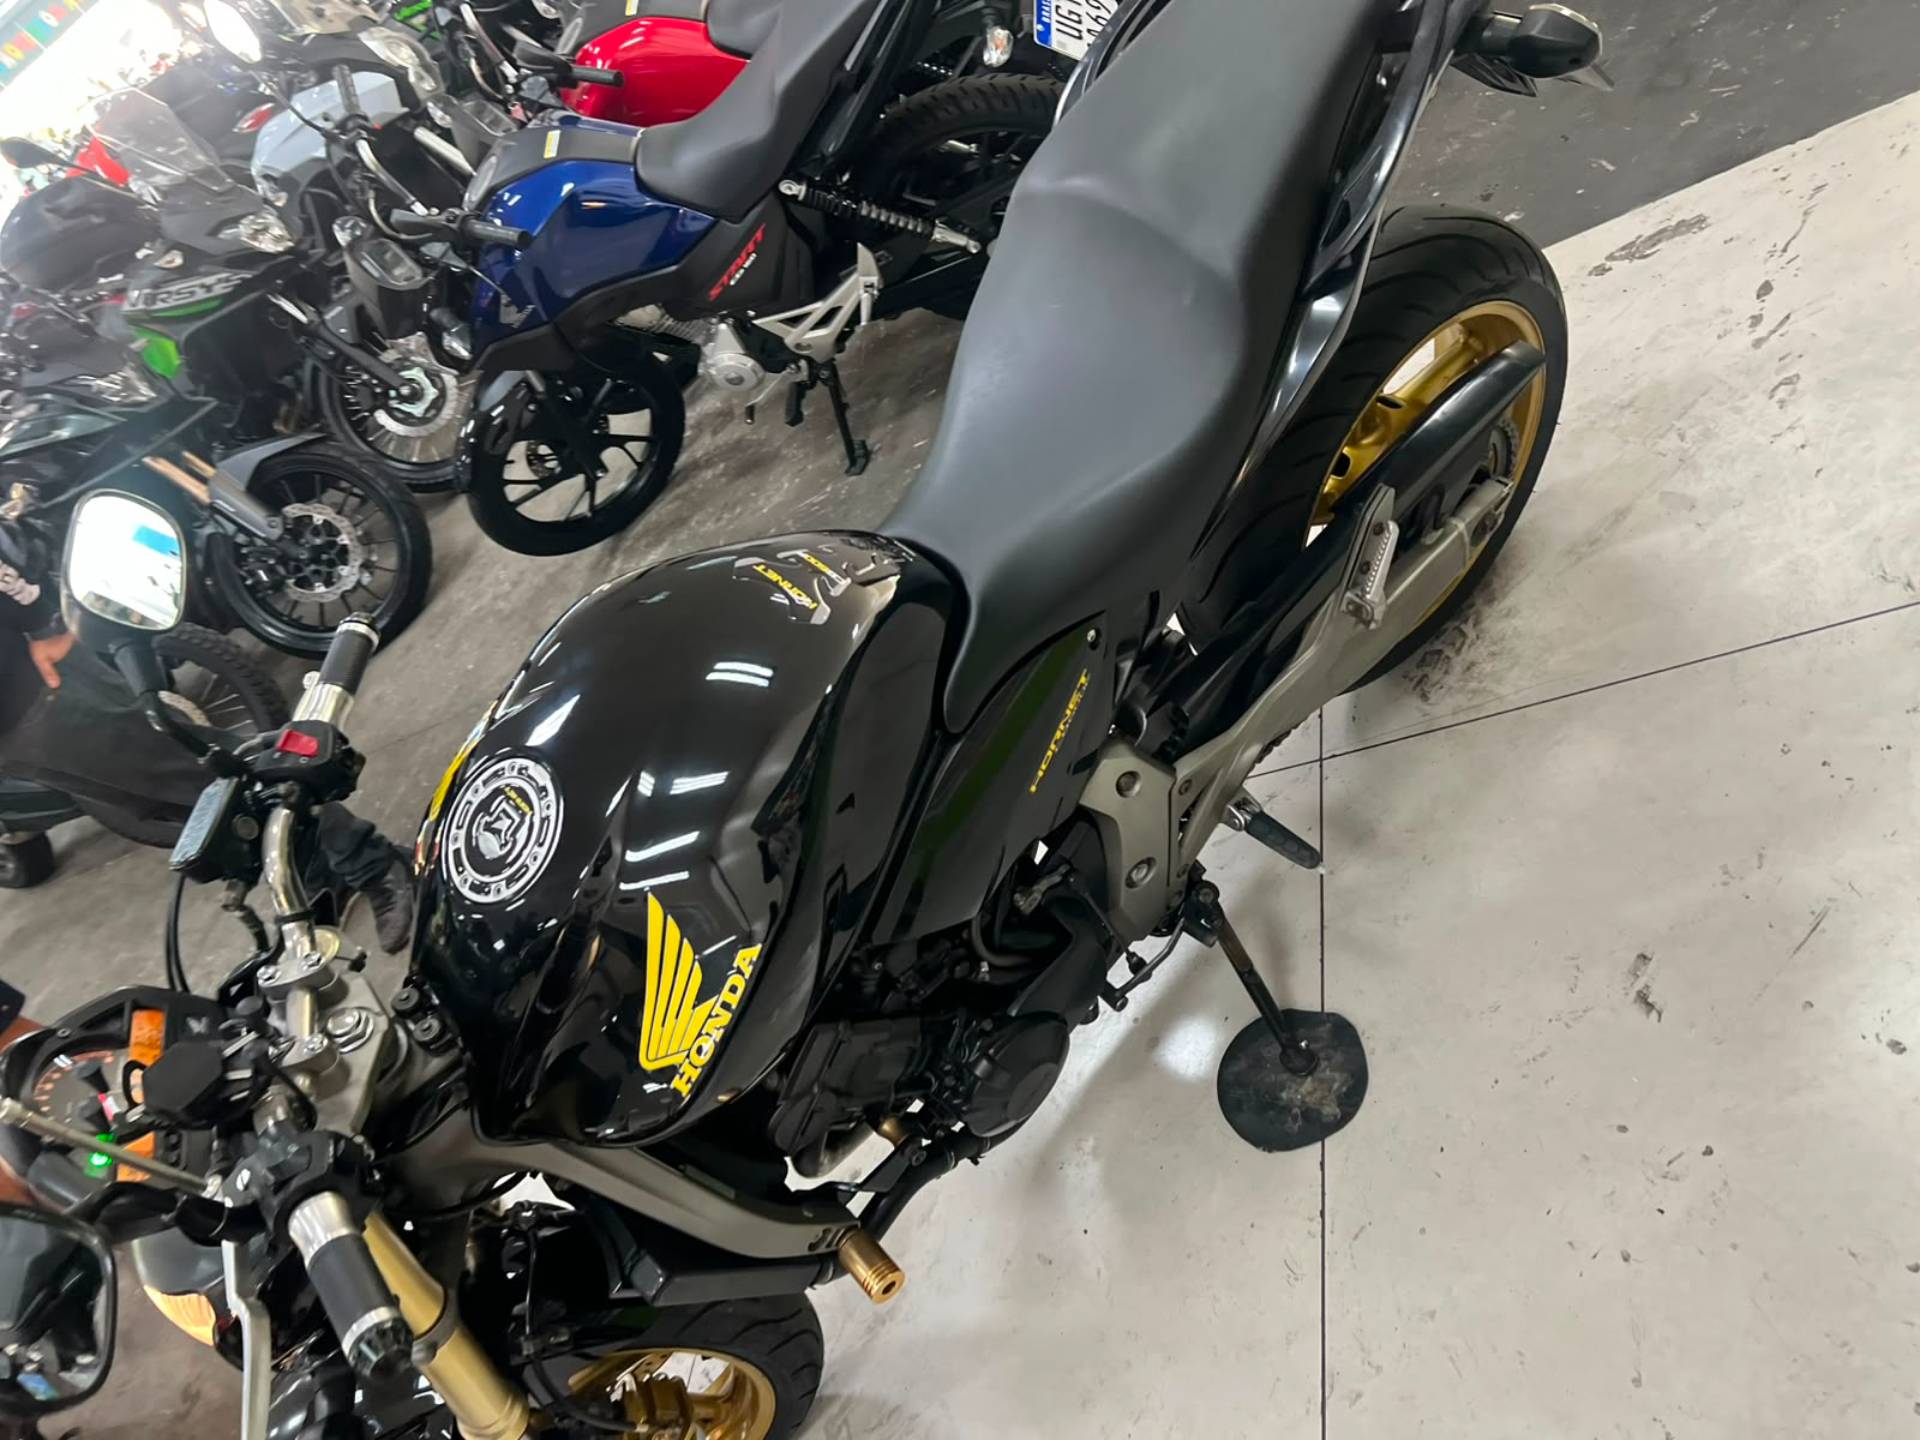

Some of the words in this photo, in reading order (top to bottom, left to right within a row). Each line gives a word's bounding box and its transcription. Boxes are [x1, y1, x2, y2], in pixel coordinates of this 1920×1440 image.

[1055, 0, 1084, 40] UG
[707, 223, 767, 302] START
[752, 563, 818, 610] HORNET
[1029, 668, 1088, 793] HORNET
[669, 942, 763, 1099] HONDA
